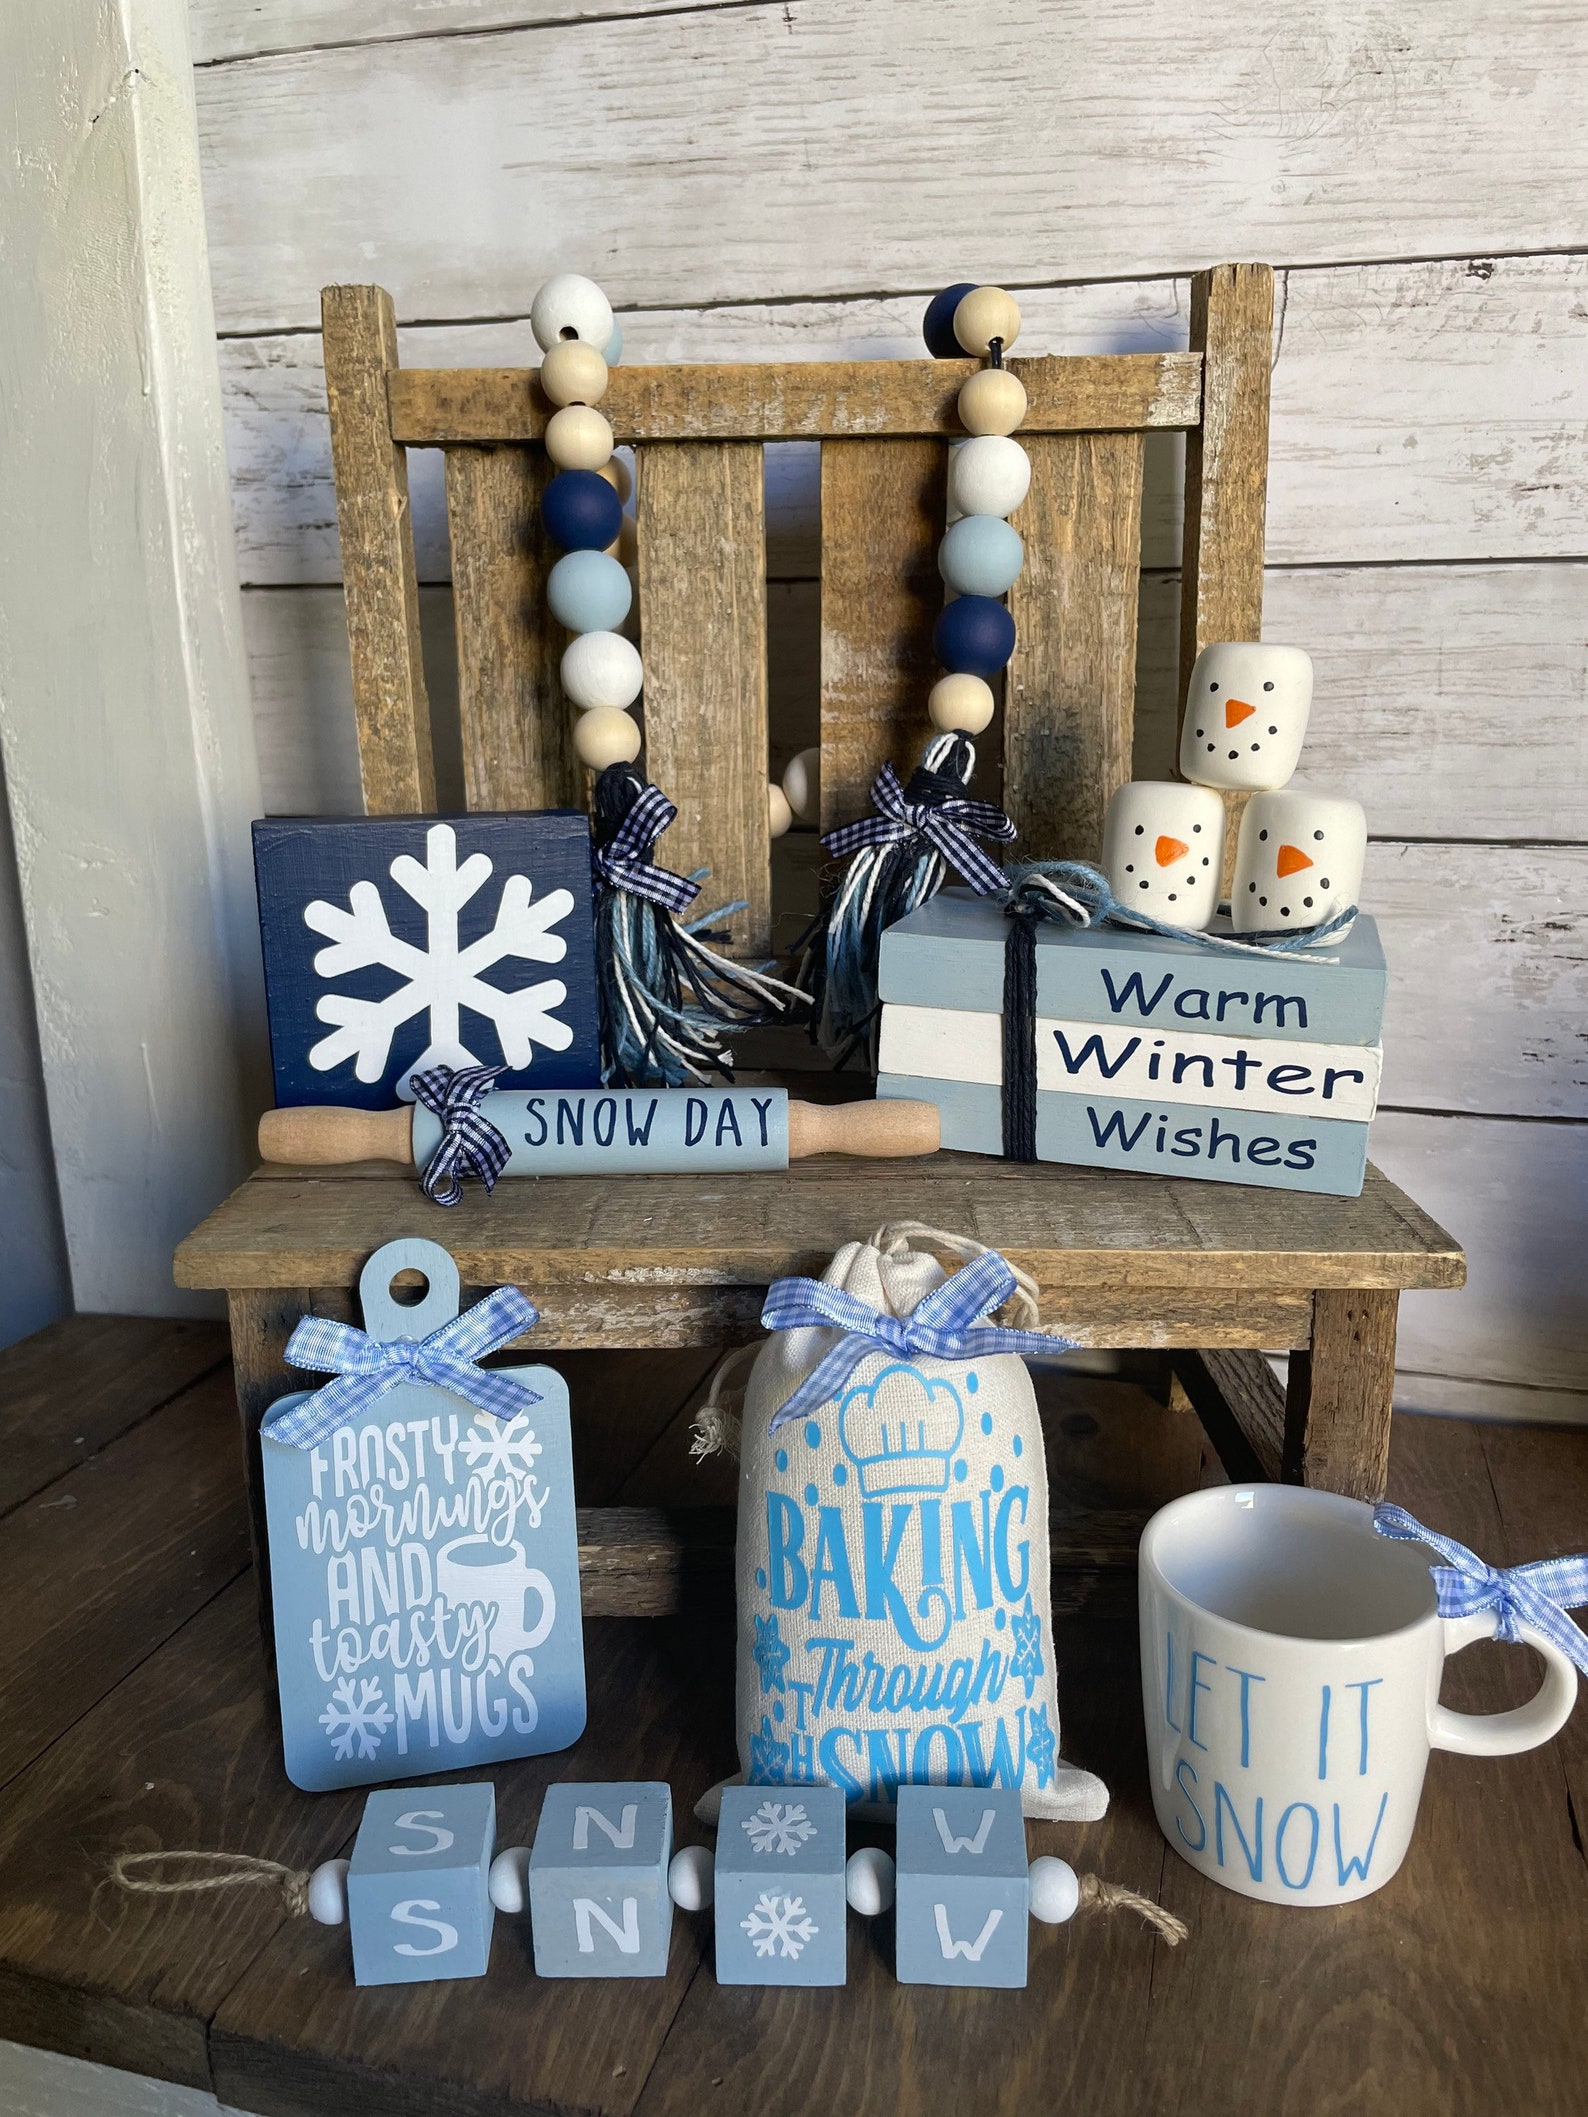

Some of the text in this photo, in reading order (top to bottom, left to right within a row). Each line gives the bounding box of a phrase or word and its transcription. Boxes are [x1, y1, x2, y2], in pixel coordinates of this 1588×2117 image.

[1100, 967, 1308, 1029] Warm
[1053, 1029, 1364, 1100] Winter
[524, 1097, 773, 1147] SNOW DAY
[1086, 1106, 1318, 1171] Wishes
[310, 1414, 460, 1500] FROSTY
[295, 1473, 550, 1554] mornings
[327, 1541, 433, 1629] AND
[765, 1484, 1030, 1652] BAKING
[309, 1596, 498, 1682] toasty
[806, 1637, 1010, 1724] Through
[394, 1653, 539, 1755] MUGS
[788, 1681, 815, 1787] TH
[1166, 1631, 1384, 1780] LET IT
[819, 1704, 1028, 1804] SNOW
[1175, 1758, 1389, 1890] SNOW
